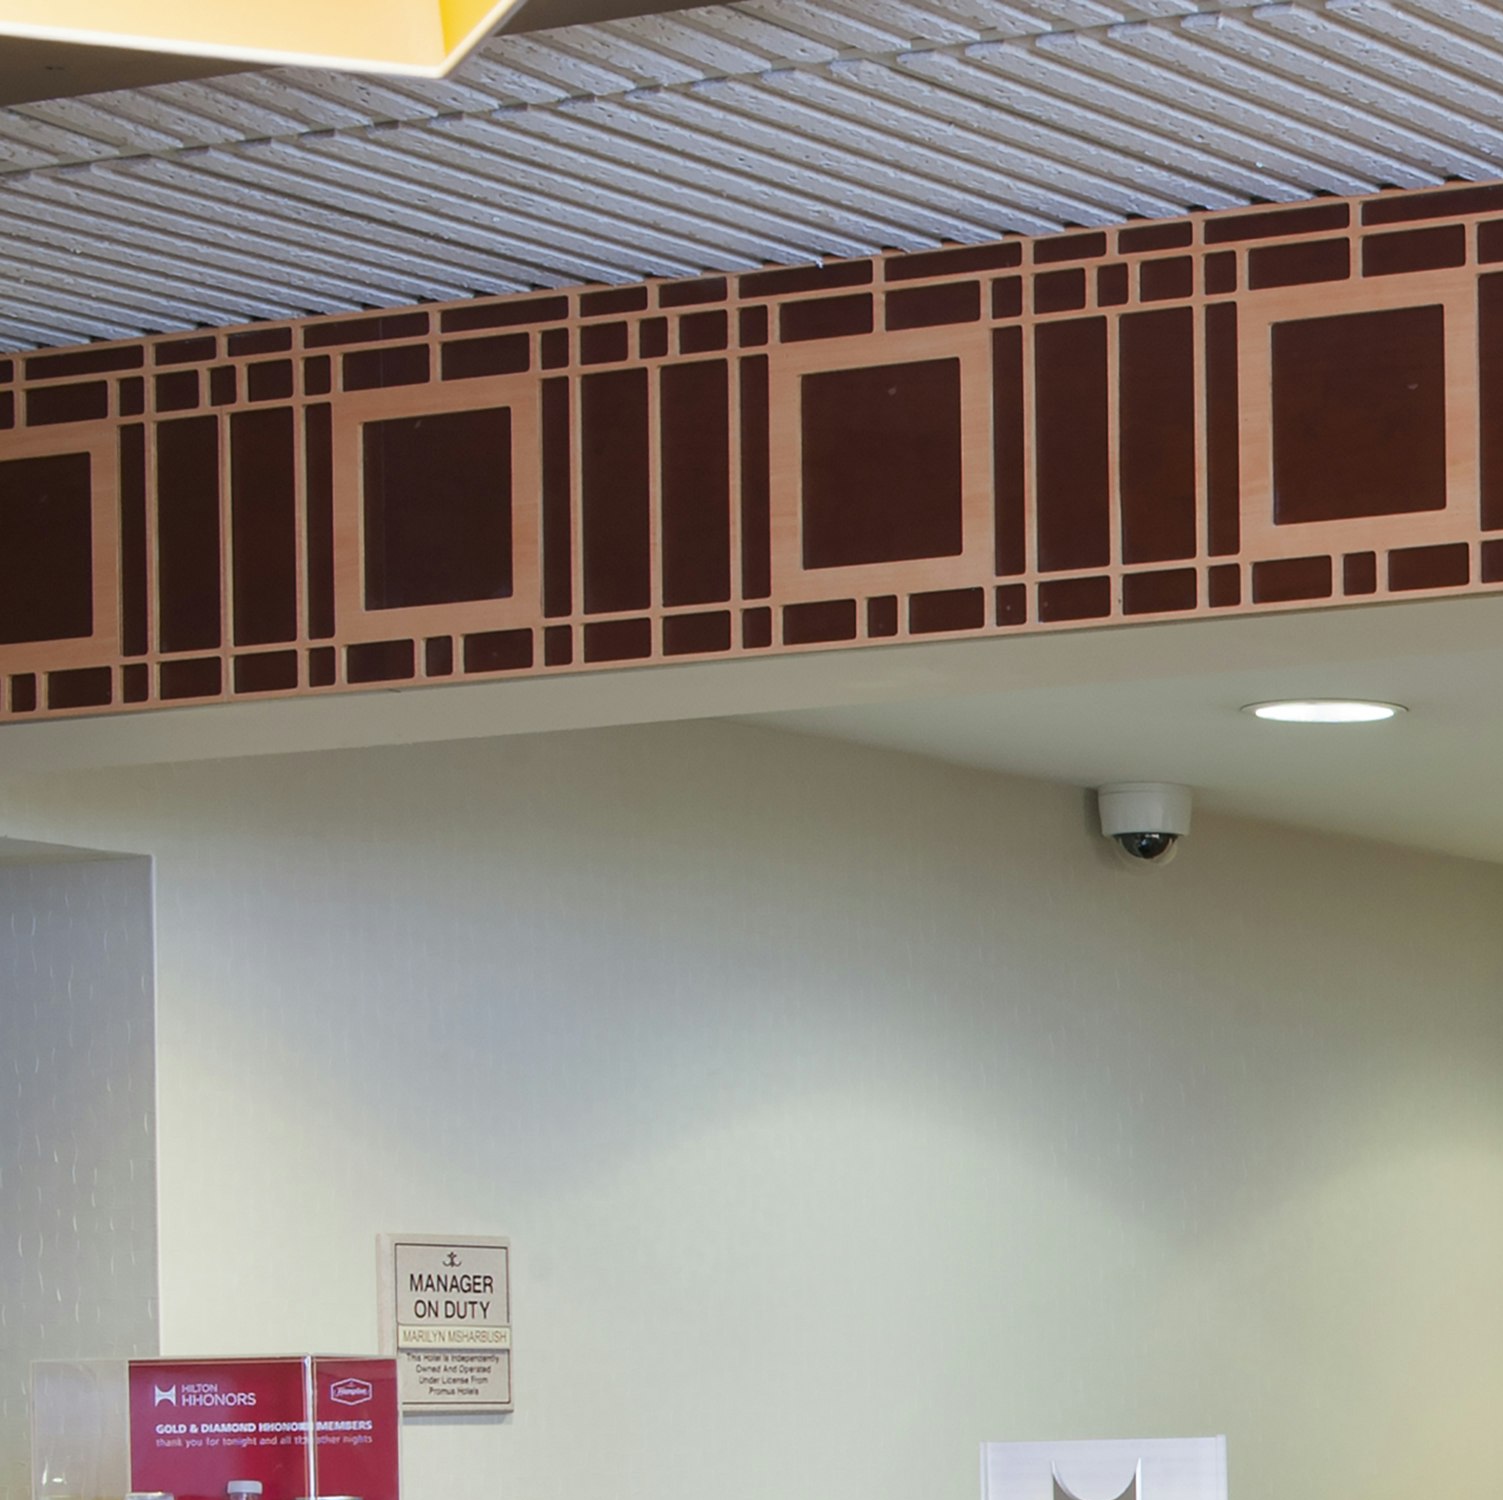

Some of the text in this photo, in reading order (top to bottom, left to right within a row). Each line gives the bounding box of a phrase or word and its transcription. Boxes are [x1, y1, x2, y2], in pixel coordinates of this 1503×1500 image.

[409, 1273, 494, 1294] MANAGER
[413, 1299, 490, 1320] ON DUTY
[402, 1329, 446, 1343] MARILYN
[416, 1364, 491, 1374] Owned And Operated
[419, 1375, 489, 1385] Under License From
[181, 1383, 218, 1393] HILTON
[181, 1392, 257, 1407] HHONORS
[155, 1420, 373, 1434] GOLD & DIAMOND HHONOR MEMBERS
[156, 1437, 182, 1447] thank
[186, 1438, 203, 1449] you
[206, 1436, 219, 1446] for
[222, 1436, 257, 1448] tonight
[259, 1436, 278, 1446] and
[280, 1435, 292, 1445] all
[342, 1435, 373, 1446] nights
